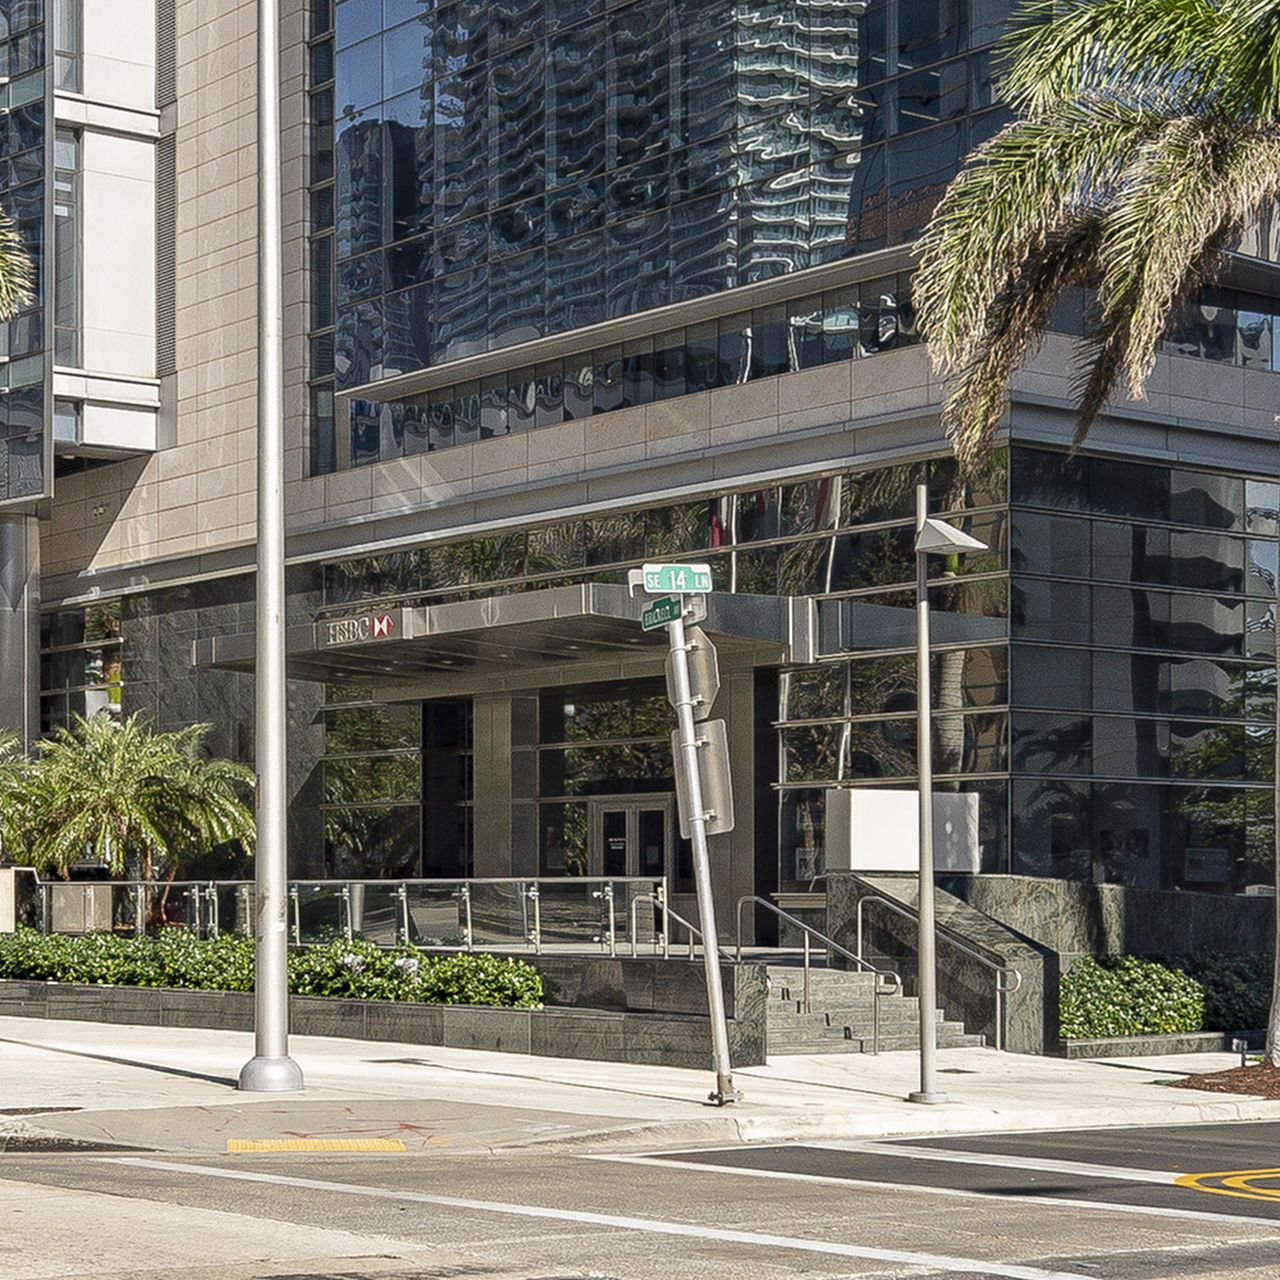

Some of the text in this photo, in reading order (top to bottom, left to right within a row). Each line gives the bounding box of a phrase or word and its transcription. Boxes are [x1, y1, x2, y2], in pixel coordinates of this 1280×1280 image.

[647, 570, 709, 590] SE 14 LN
[326, 617, 369, 645] HSBC
